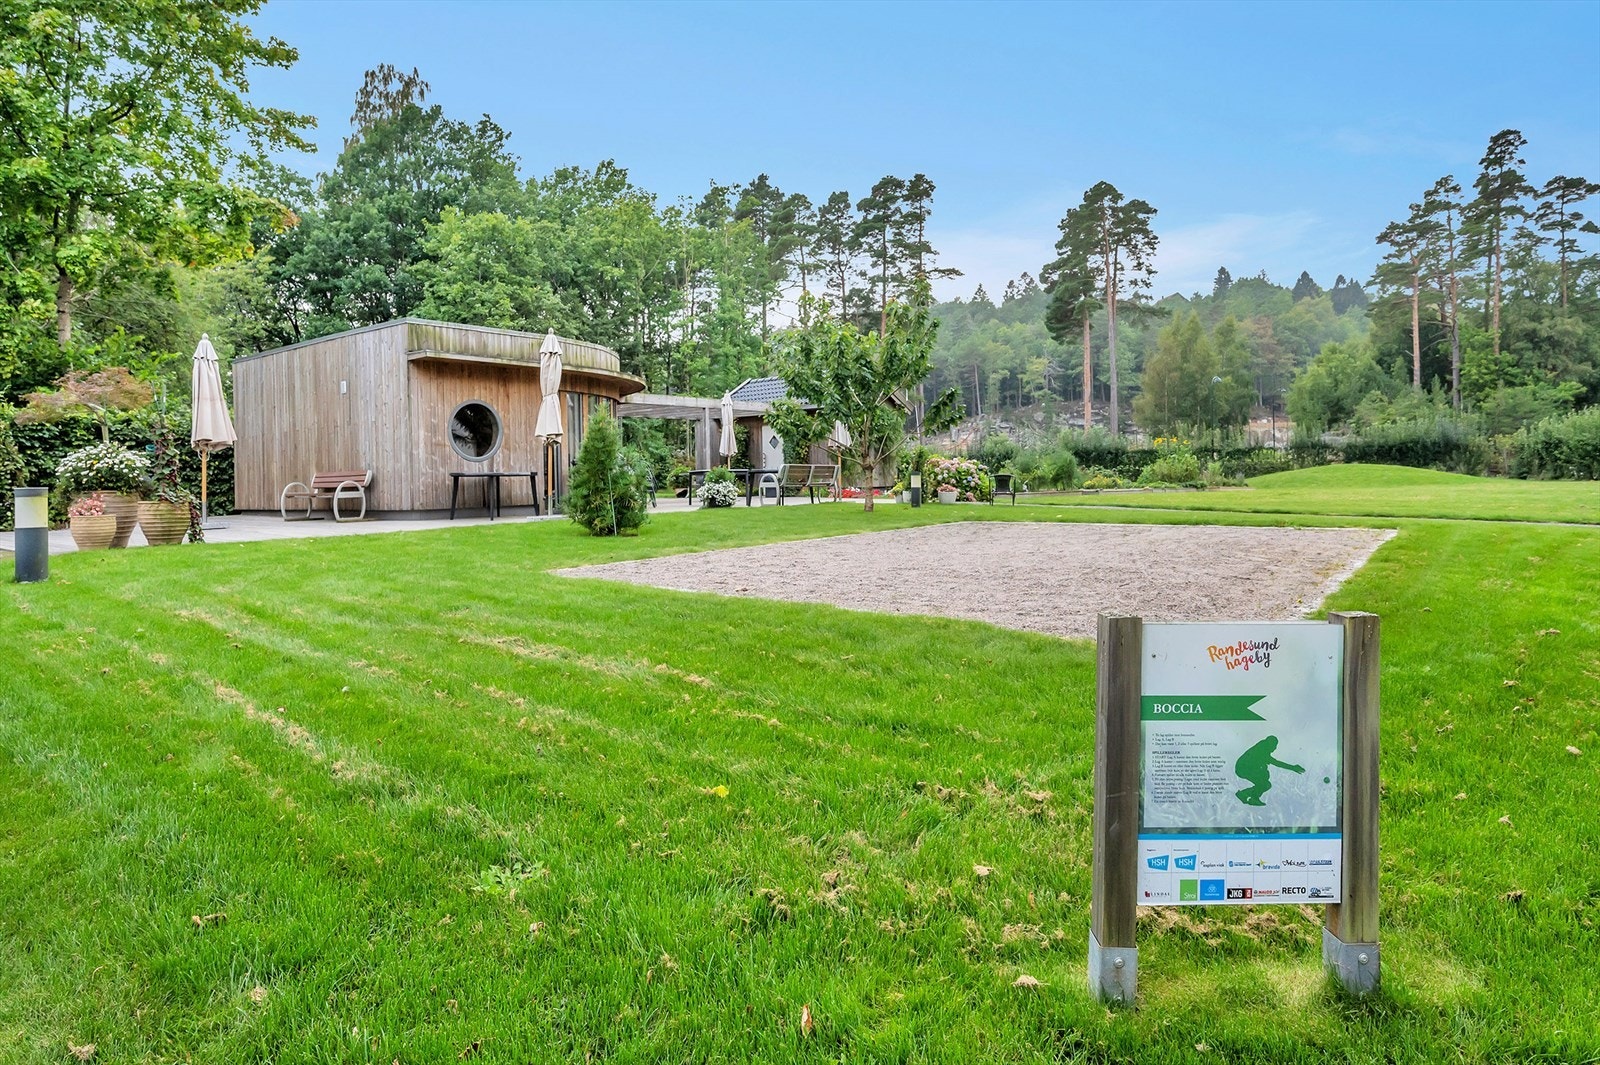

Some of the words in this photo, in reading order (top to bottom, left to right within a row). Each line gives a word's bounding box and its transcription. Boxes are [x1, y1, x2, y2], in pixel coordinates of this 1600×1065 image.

[1207, 637, 1280, 663] Randesund
[1225, 651, 1272, 671] hageby
[1153, 703, 1203, 714] BOCCIA
[1229, 890, 1242, 898] JKG
[1282, 886, 1306, 894] RECTO
